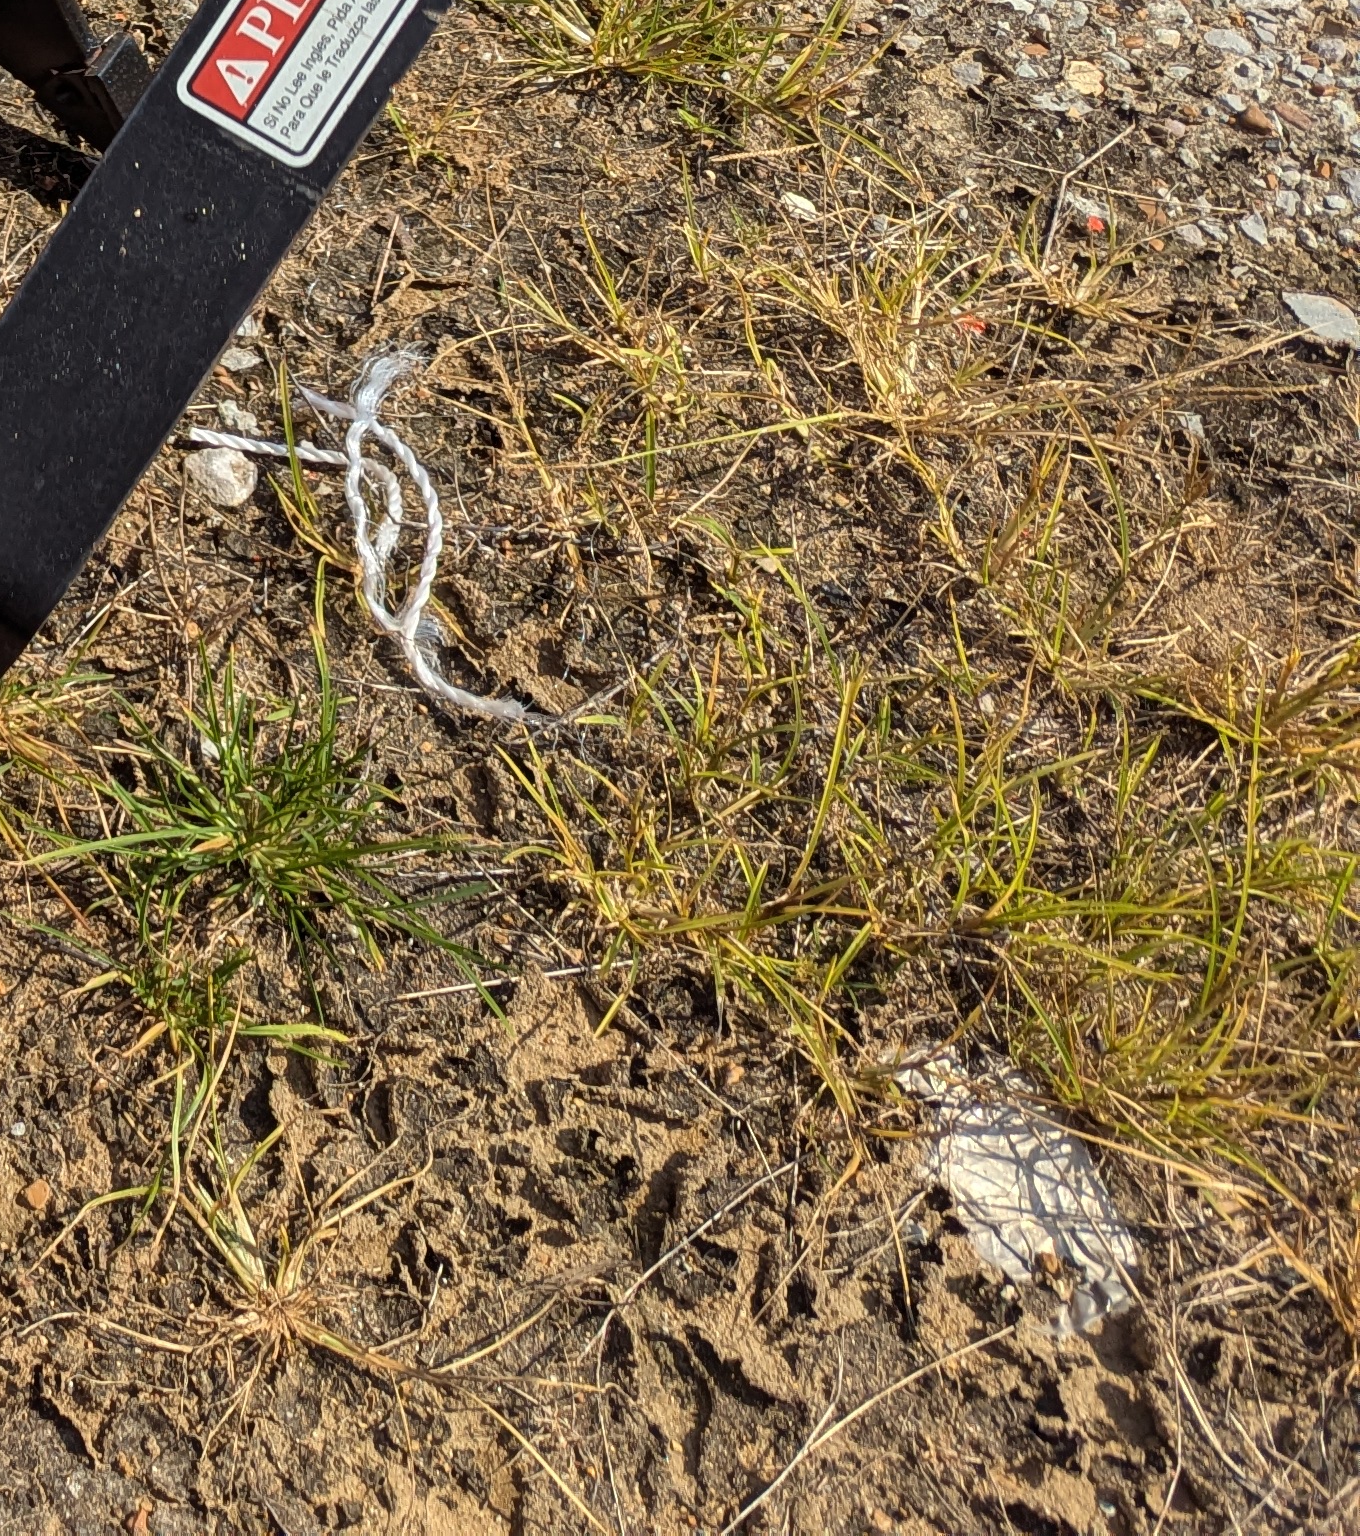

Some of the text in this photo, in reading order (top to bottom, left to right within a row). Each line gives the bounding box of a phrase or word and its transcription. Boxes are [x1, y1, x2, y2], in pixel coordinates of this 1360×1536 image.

[326, 2, 353, 32] Pida
[279, 109, 307, 140] Para
[299, 82, 323, 109] Que
[315, 69, 332, 84] le
[324, 14, 369, 69] Traduzca
[284, 71, 307, 97] Lee
[271, 95, 292, 116] No
[263, 112, 280, 130] Si
